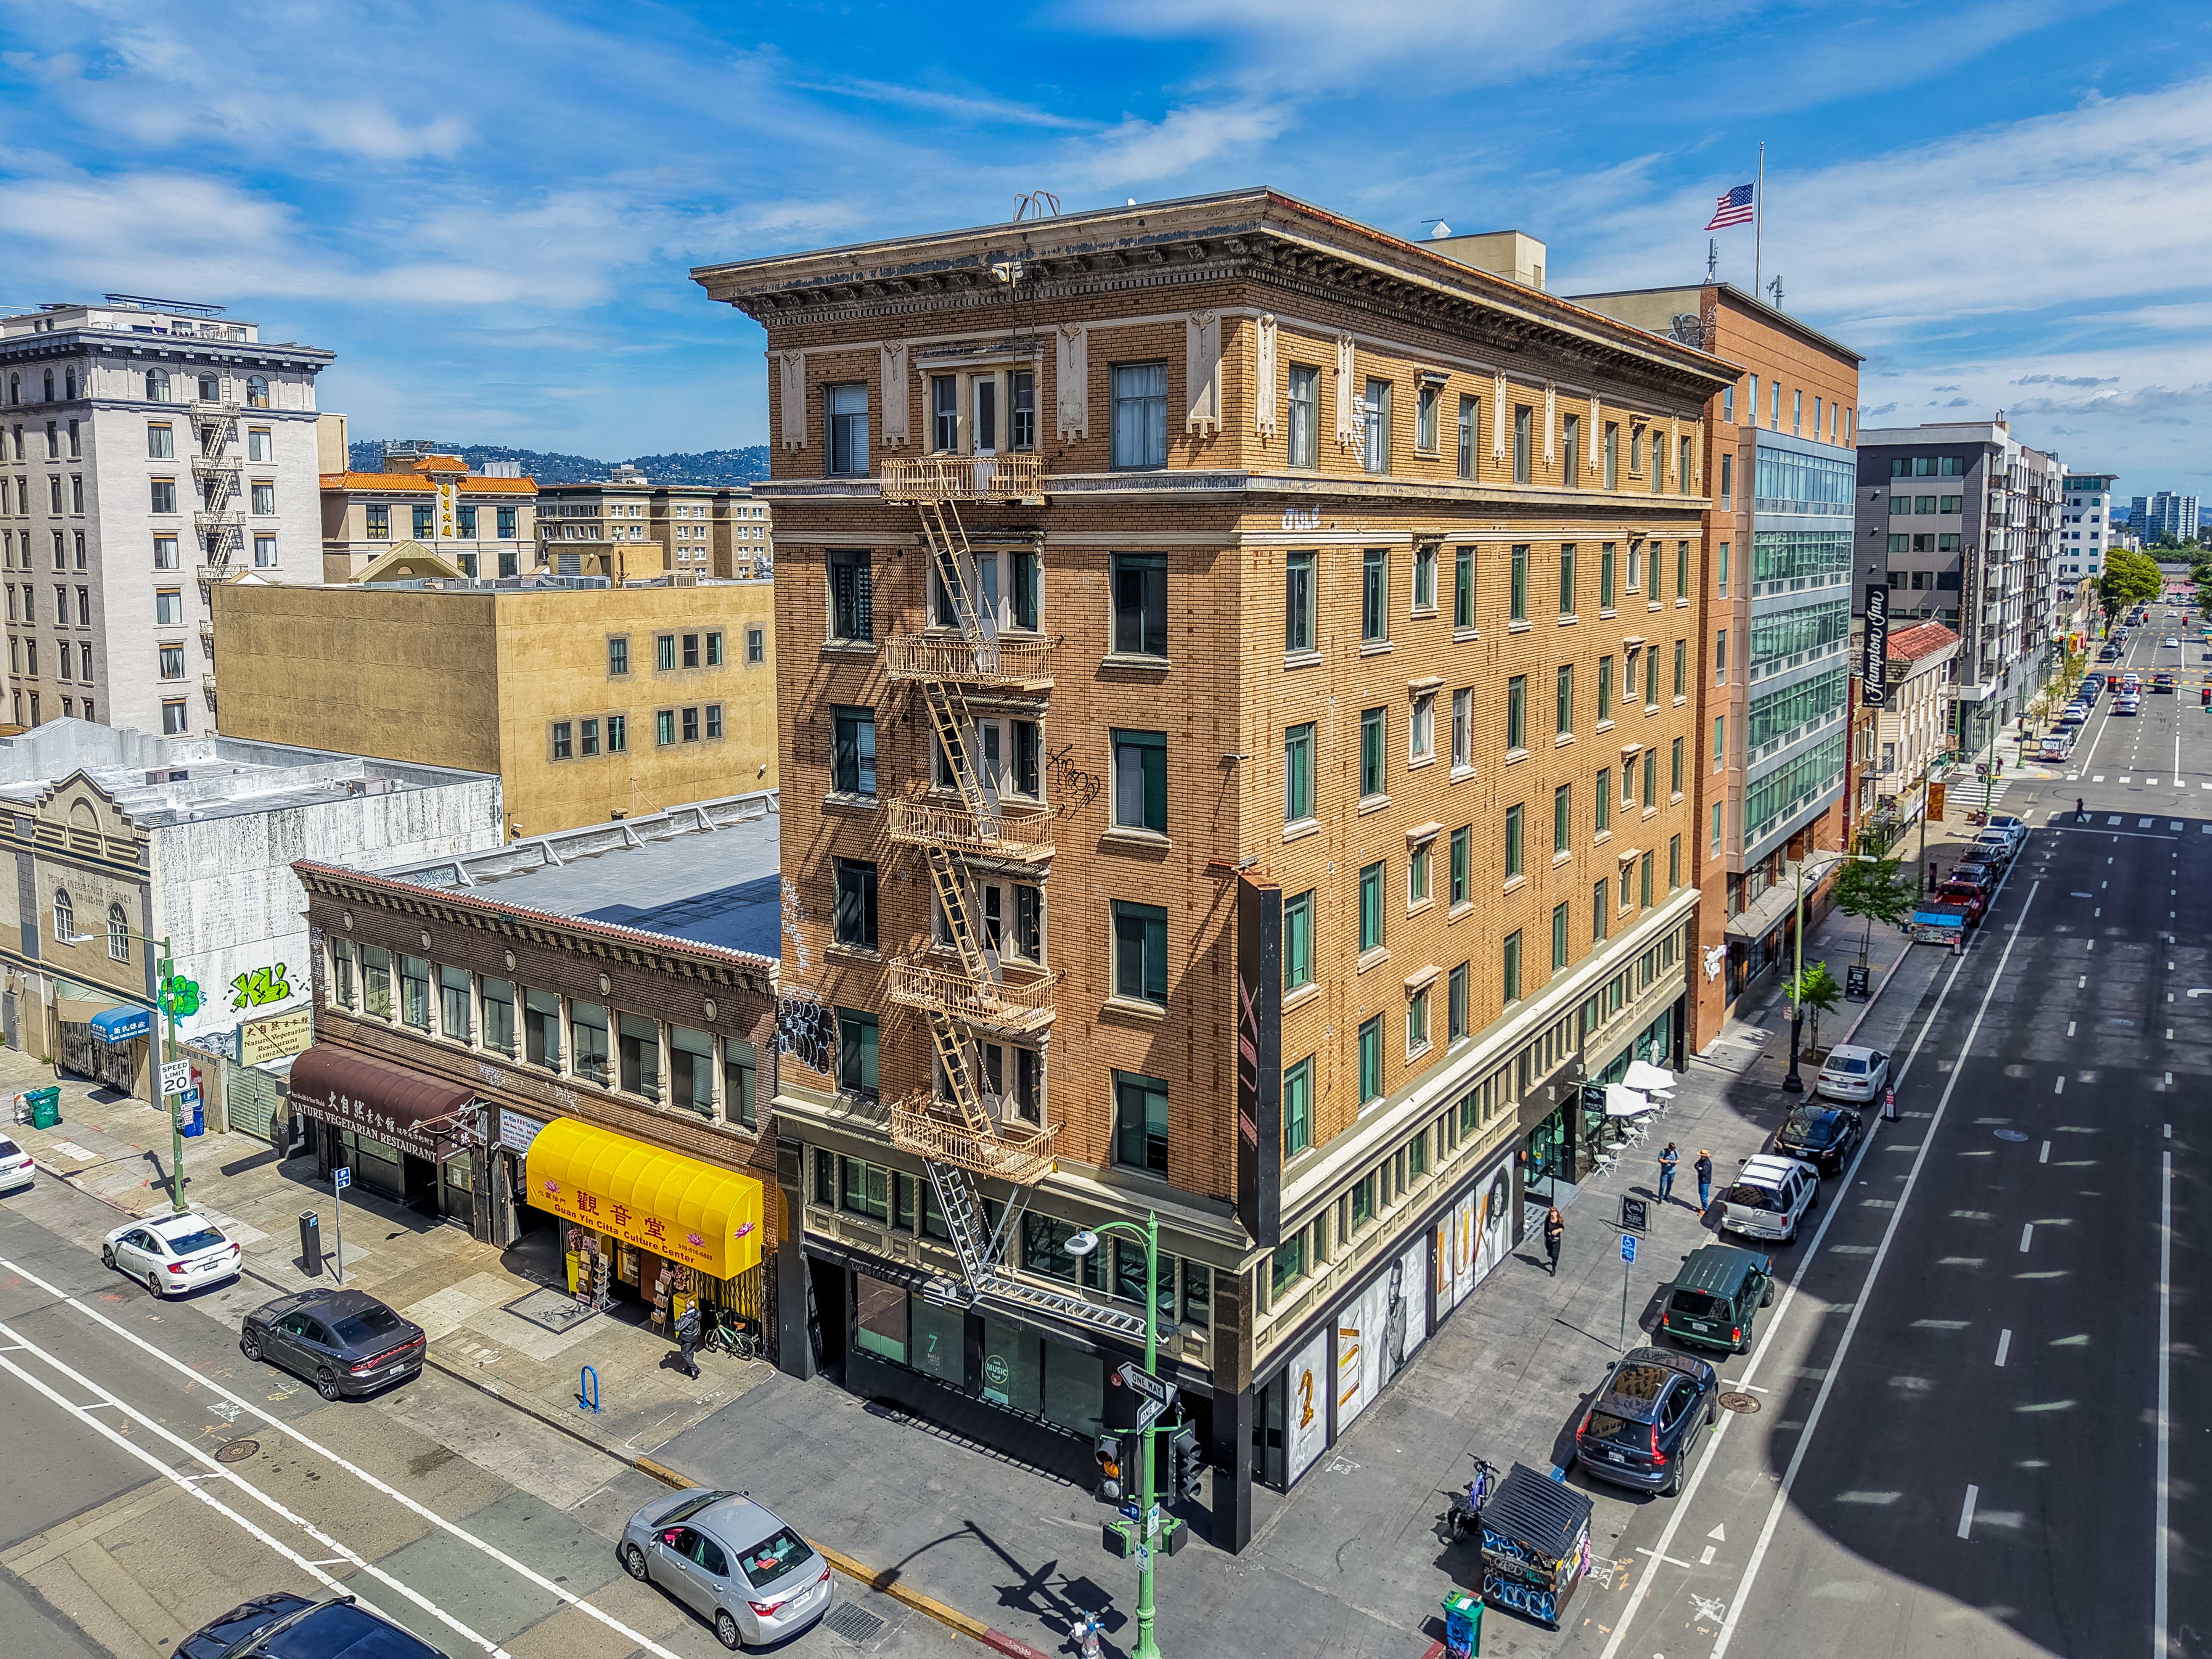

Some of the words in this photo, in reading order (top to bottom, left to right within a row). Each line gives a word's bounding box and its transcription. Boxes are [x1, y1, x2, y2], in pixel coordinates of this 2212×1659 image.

[1867, 591, 1886, 626] Inn
[1865, 627, 1883, 701] Hampton
[244, 1037, 270, 1048] Nature
[271, 1026, 310, 1040] Vegetarian
[257, 1037, 297, 1052] Restaurant
[162, 1062, 187, 1073] SPEED
[165, 1069, 185, 1079] LIMIT
[164, 1077, 187, 1092] 20
[328, 1091, 395, 1133] 大自然素食館
[291, 1101, 323, 1120] NATURE
[325, 1111, 378, 1140] VEGETARIAN
[380, 1133, 437, 1162] RESTAURANT
[576, 1190, 666, 1241] 觀音堂
[554, 1203, 577, 1218] Guan
[579, 1213, 593, 1225] Yin
[596, 1220, 619, 1235] Citta
[624, 1231, 658, 1250] Culture
[662, 1245, 694, 1264] Center
[928, 1334, 938, 1353] 7
[987, 1363, 1007, 1376] MUSIC
[1132, 1373, 1146, 1387] ONE
[1147, 1380, 1161, 1395] WAY
[1141, 1405, 1153, 1422] ONE
